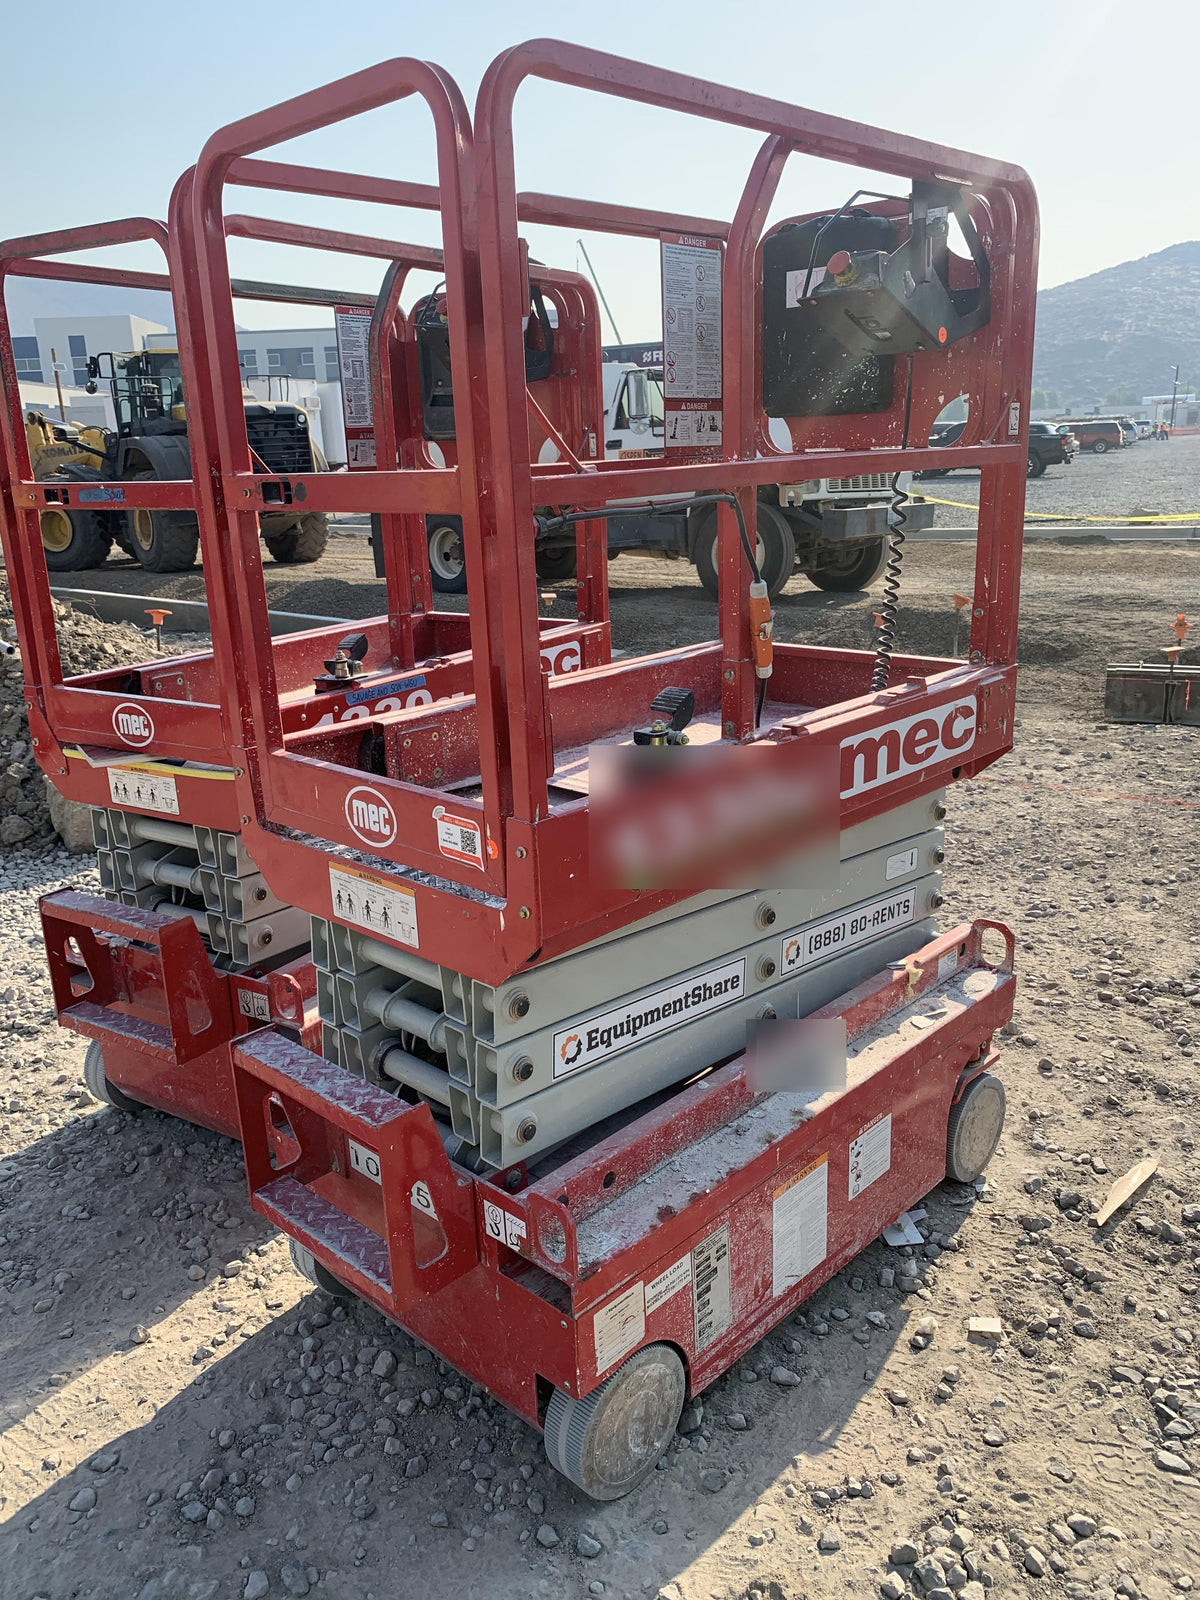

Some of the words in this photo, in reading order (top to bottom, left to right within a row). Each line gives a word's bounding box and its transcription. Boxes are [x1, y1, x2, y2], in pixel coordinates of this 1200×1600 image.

[684, 237, 707, 247] DANGER
[353, 308, 370, 316] DANGER
[686, 402, 708, 410] DANGER
[376, 686, 389, 697] AND
[117, 713, 150, 737] mec
[839, 704, 975, 793] mec
[352, 799, 391, 836] mec
[808, 922, 846, 955] (888)
[850, 898, 911, 935] 80-RENTS
[586, 972, 740, 1052] EquipmentShare
[863, 1112, 883, 1131] DANGER
[651, 1274, 670, 1290] WHEEL
[669, 1261, 684, 1276] LOAD
